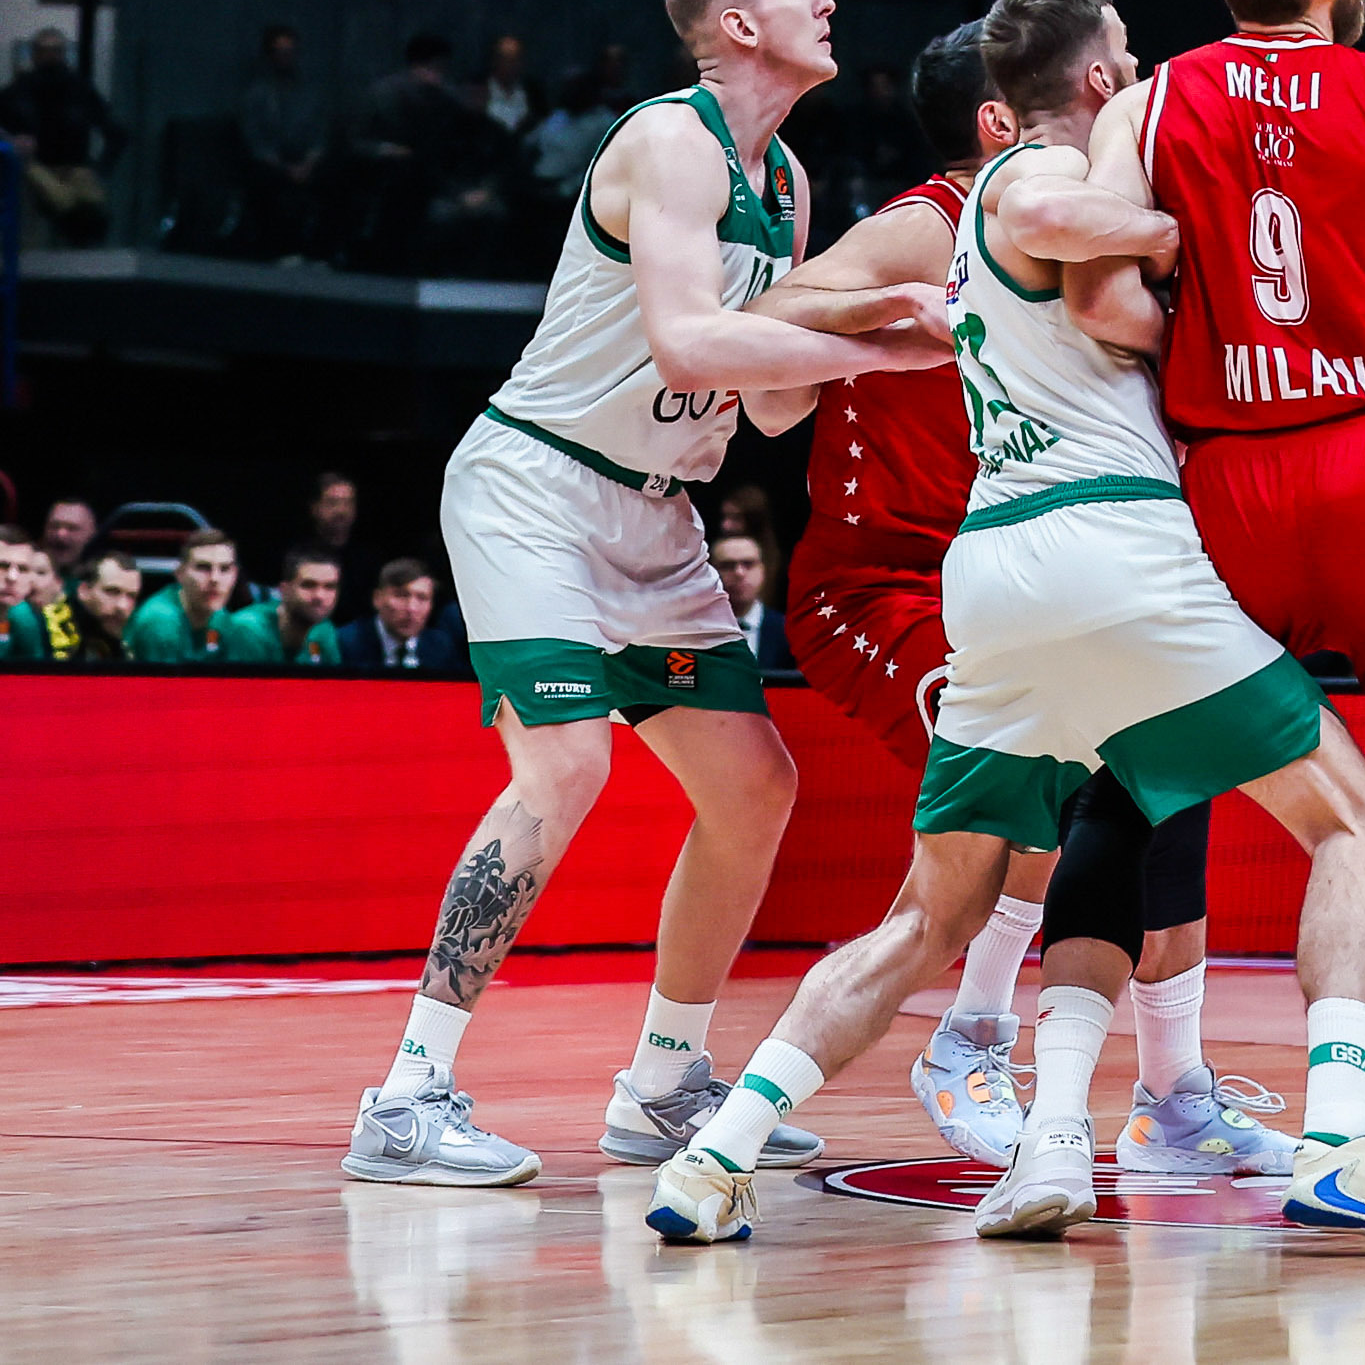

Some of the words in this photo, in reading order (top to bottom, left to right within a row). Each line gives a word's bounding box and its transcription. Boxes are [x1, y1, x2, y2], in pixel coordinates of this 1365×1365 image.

[1225, 62, 1321, 113] MELLI
[1249, 187, 1310, 326] 9
[402, 1038, 428, 1058] SA
[648, 1032, 692, 1052] GSA
